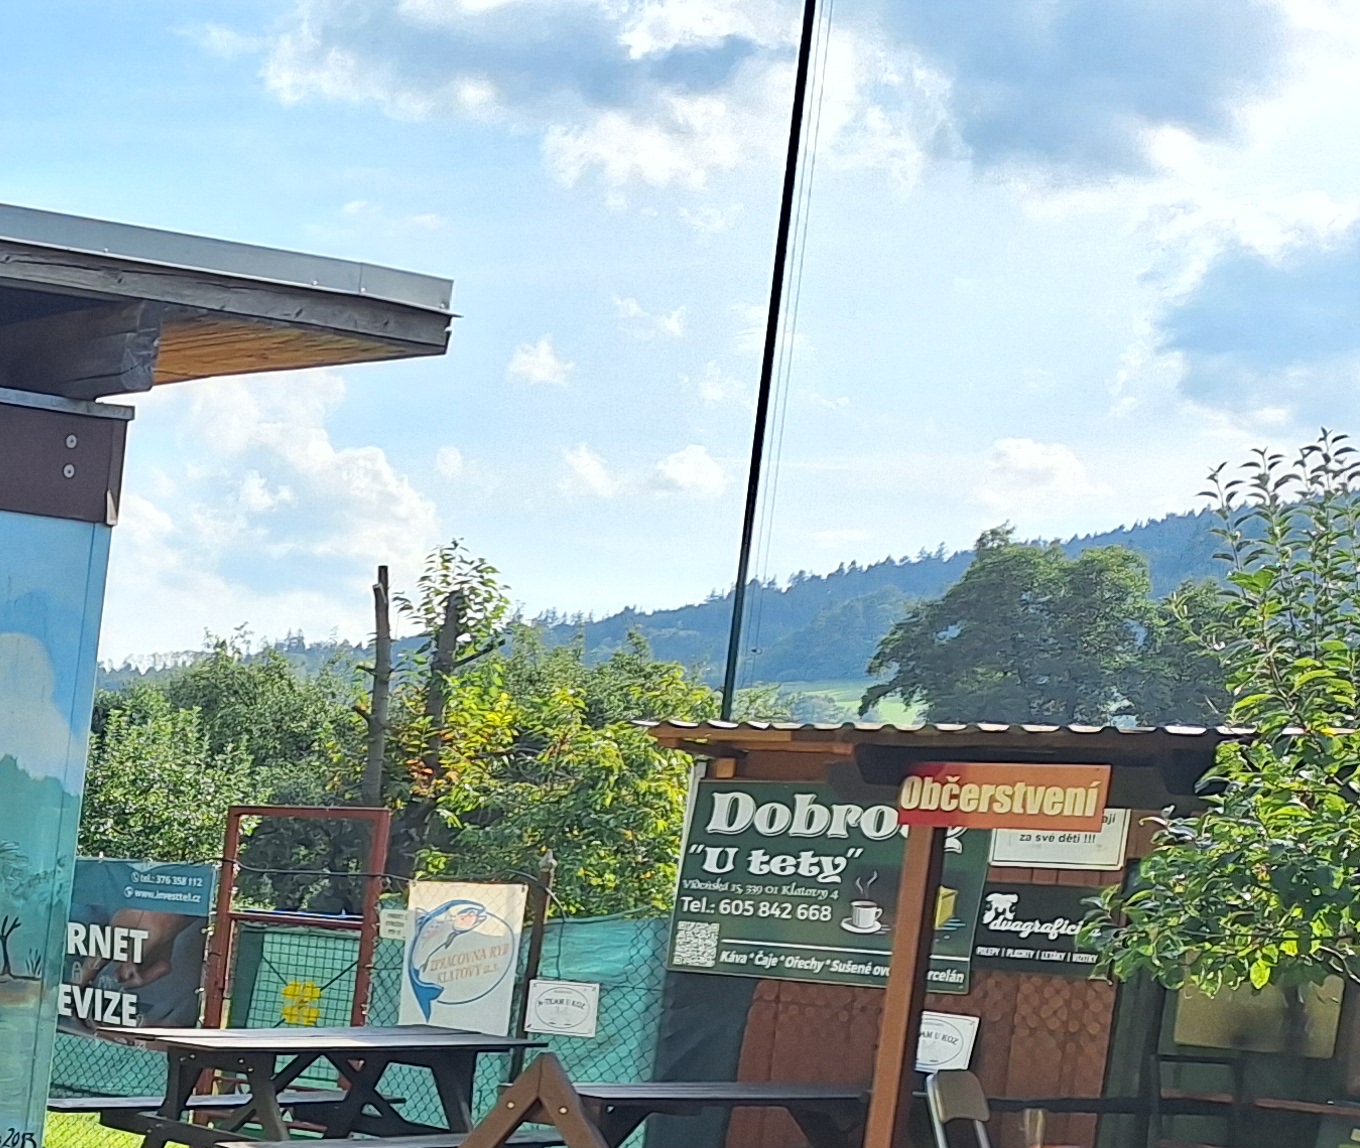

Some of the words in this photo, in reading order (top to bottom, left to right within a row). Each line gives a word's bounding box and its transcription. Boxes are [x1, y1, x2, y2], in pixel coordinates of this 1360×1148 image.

[900, 775, 1102, 817] Občerstvení
[705, 791, 968, 854] Dobro
[1019, 834, 1033, 842] za
[1035, 832, 1055, 843] své
[1058, 833, 1081, 843] děti
[156, 875, 171, 885] 376
[172, 876, 187, 886] 358
[188, 877, 203, 887] 112
[764, 885, 778, 894] 01
[781, 882, 828, 900] Klatovy
[830, 889, 839, 900] 4
[680, 896, 715, 914] Tel.:
[719, 899, 755, 916] 605
[757, 901, 793, 919] 842
[796, 904, 832, 922] 668
[719, 950, 748, 966] Káva
[754, 951, 778, 970] Čaje
[784, 955, 824, 973] Ořechy
[830, 957, 872, 976] Sušené
[927, 968, 964, 984] rcelán
